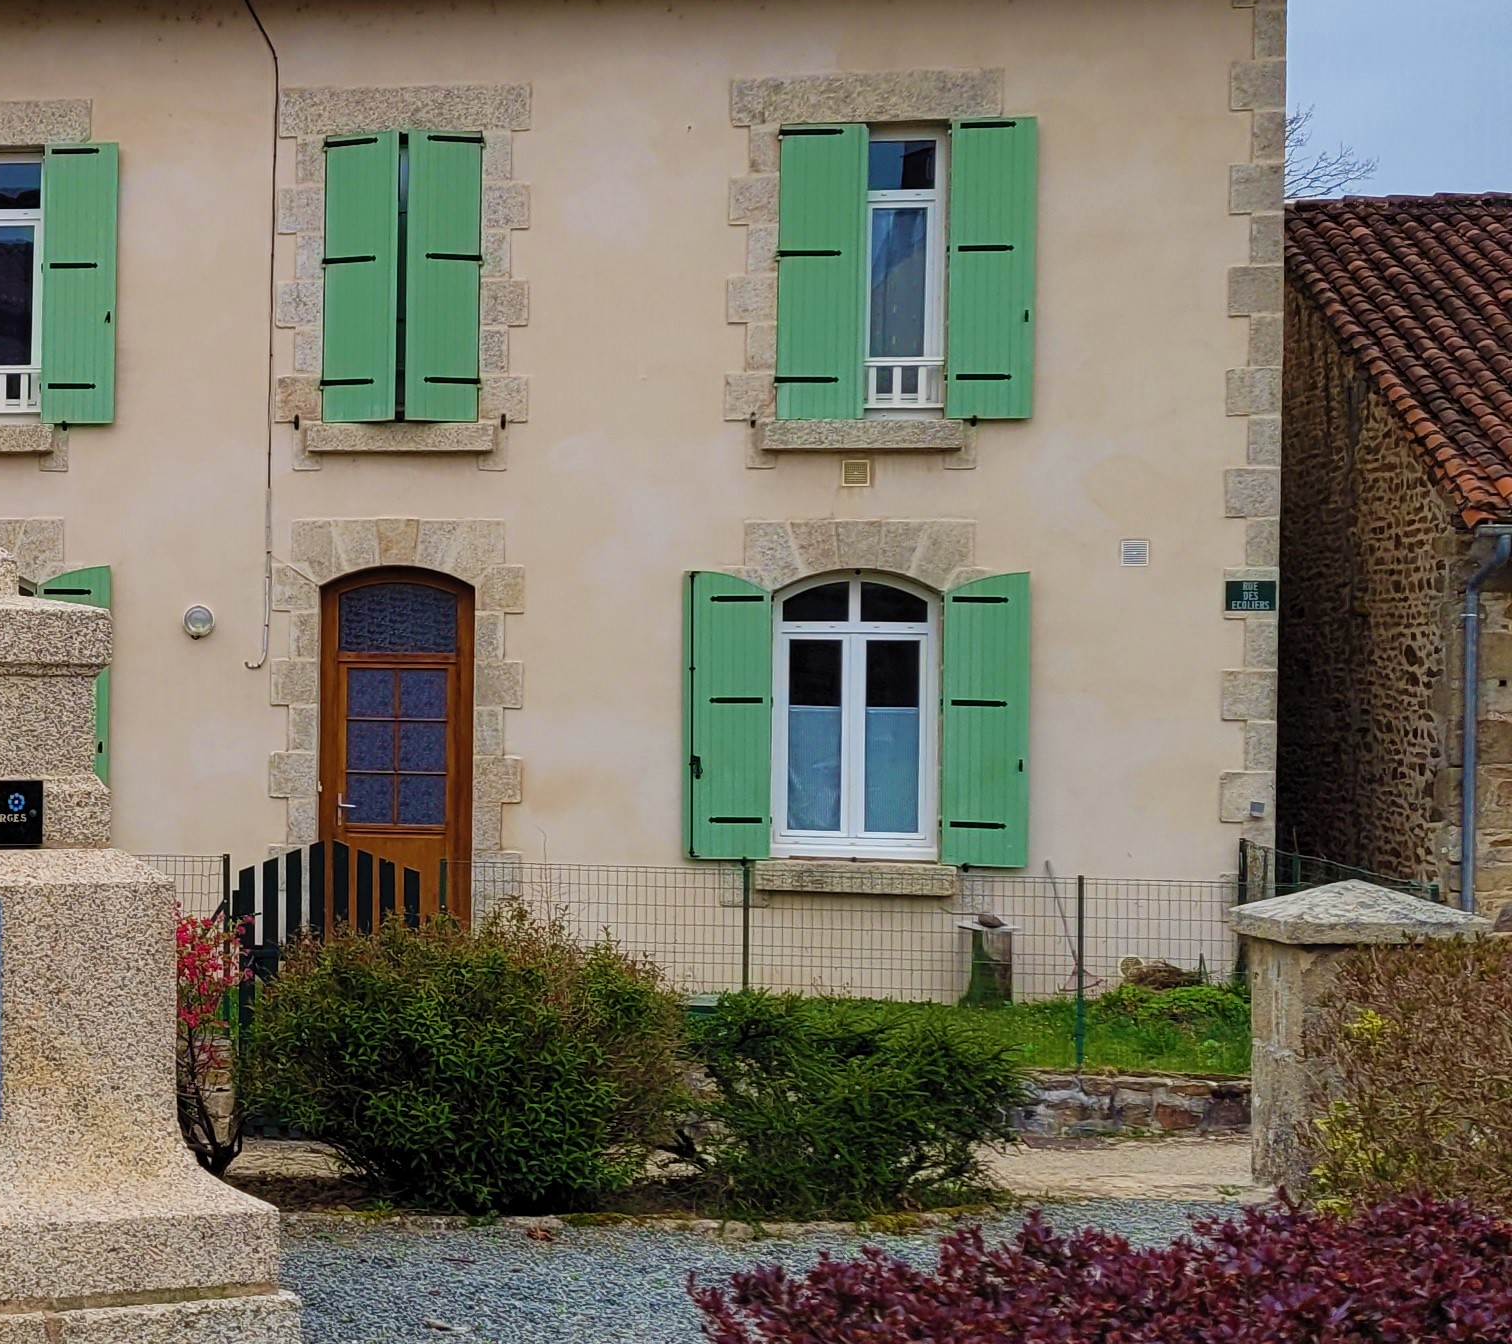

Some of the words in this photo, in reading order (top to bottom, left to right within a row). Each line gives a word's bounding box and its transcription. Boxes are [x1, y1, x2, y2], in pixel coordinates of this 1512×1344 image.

[1242, 582, 1259, 590] RUE
[1243, 591, 1259, 600] DES
[1231, 600, 1270, 610] ECOLIERS
